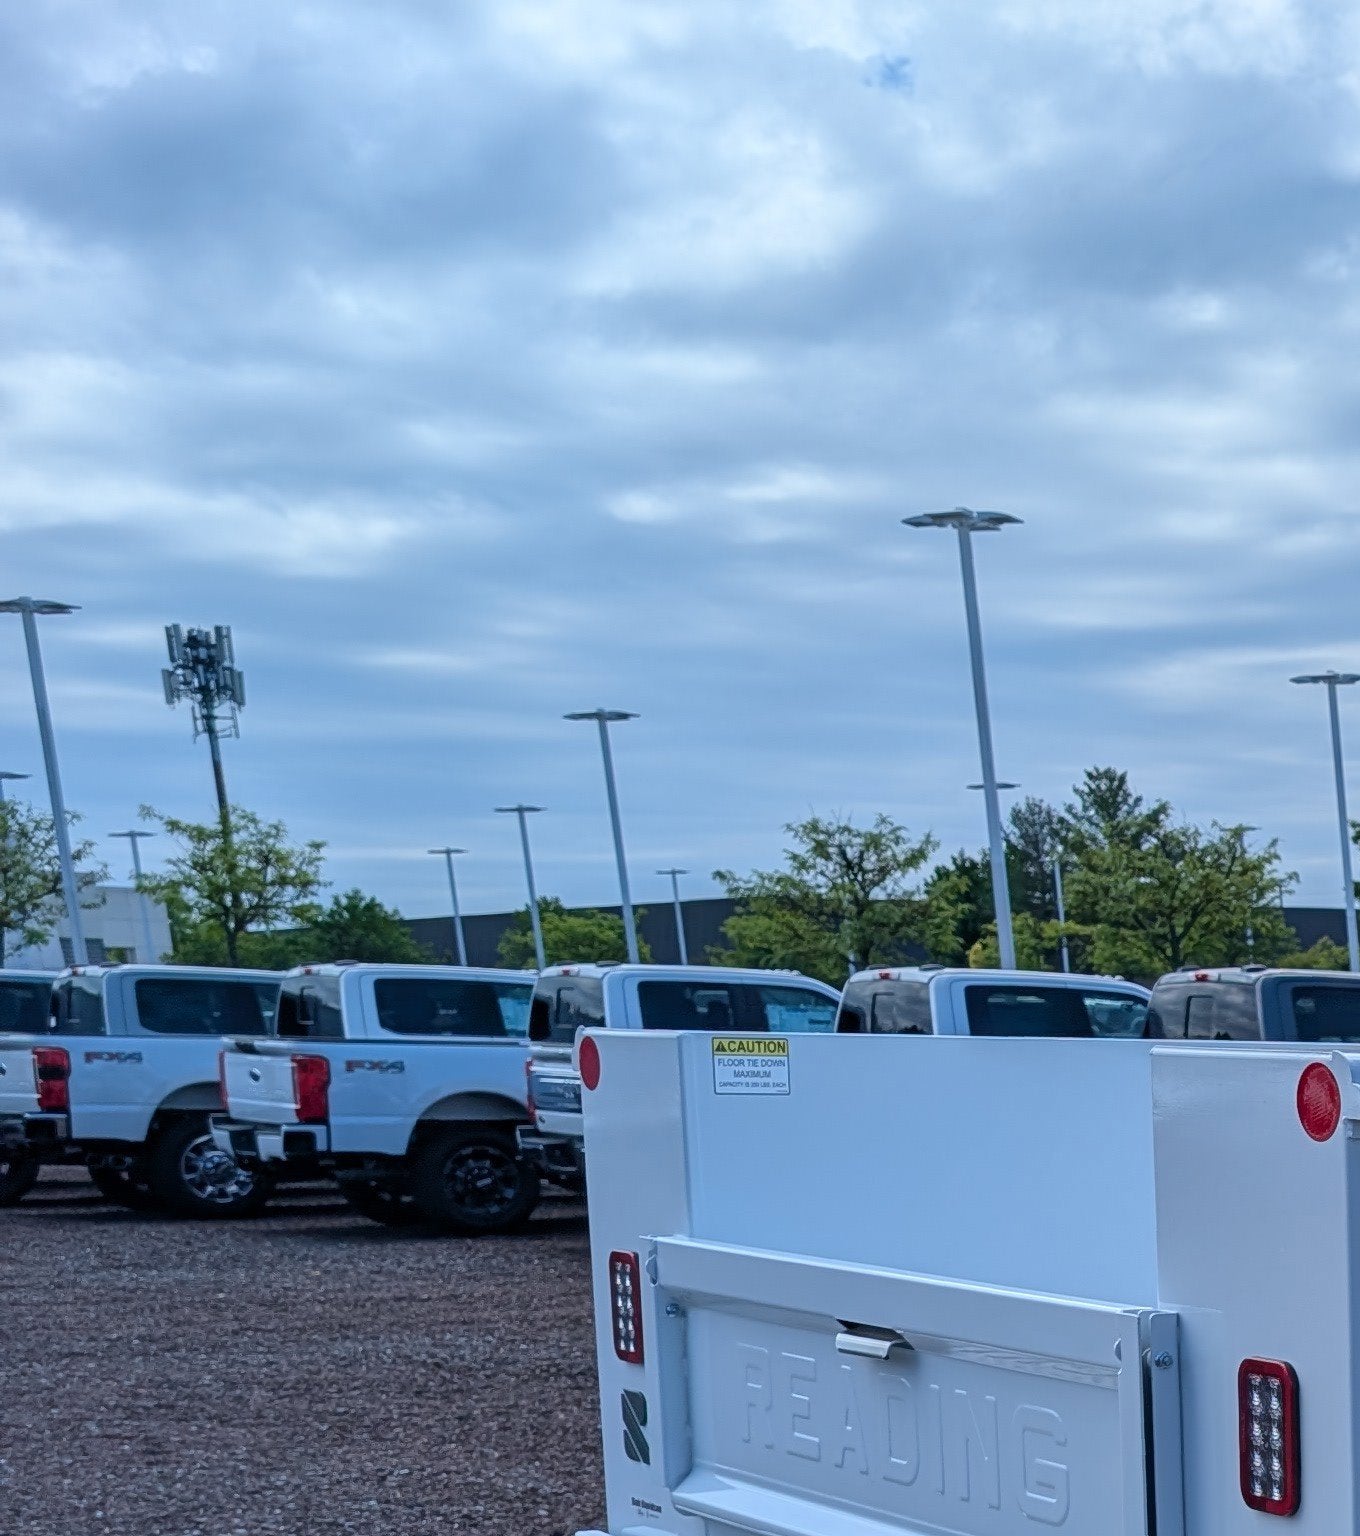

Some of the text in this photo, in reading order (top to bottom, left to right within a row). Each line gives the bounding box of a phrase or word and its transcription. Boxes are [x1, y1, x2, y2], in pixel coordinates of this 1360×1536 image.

[727, 1041, 786, 1053] CAUTION
[718, 1058, 786, 1067] FLOOR TIE DOWN
[733, 1070, 772, 1078] MAXIMUM
[735, 1338, 1071, 1528] READING
